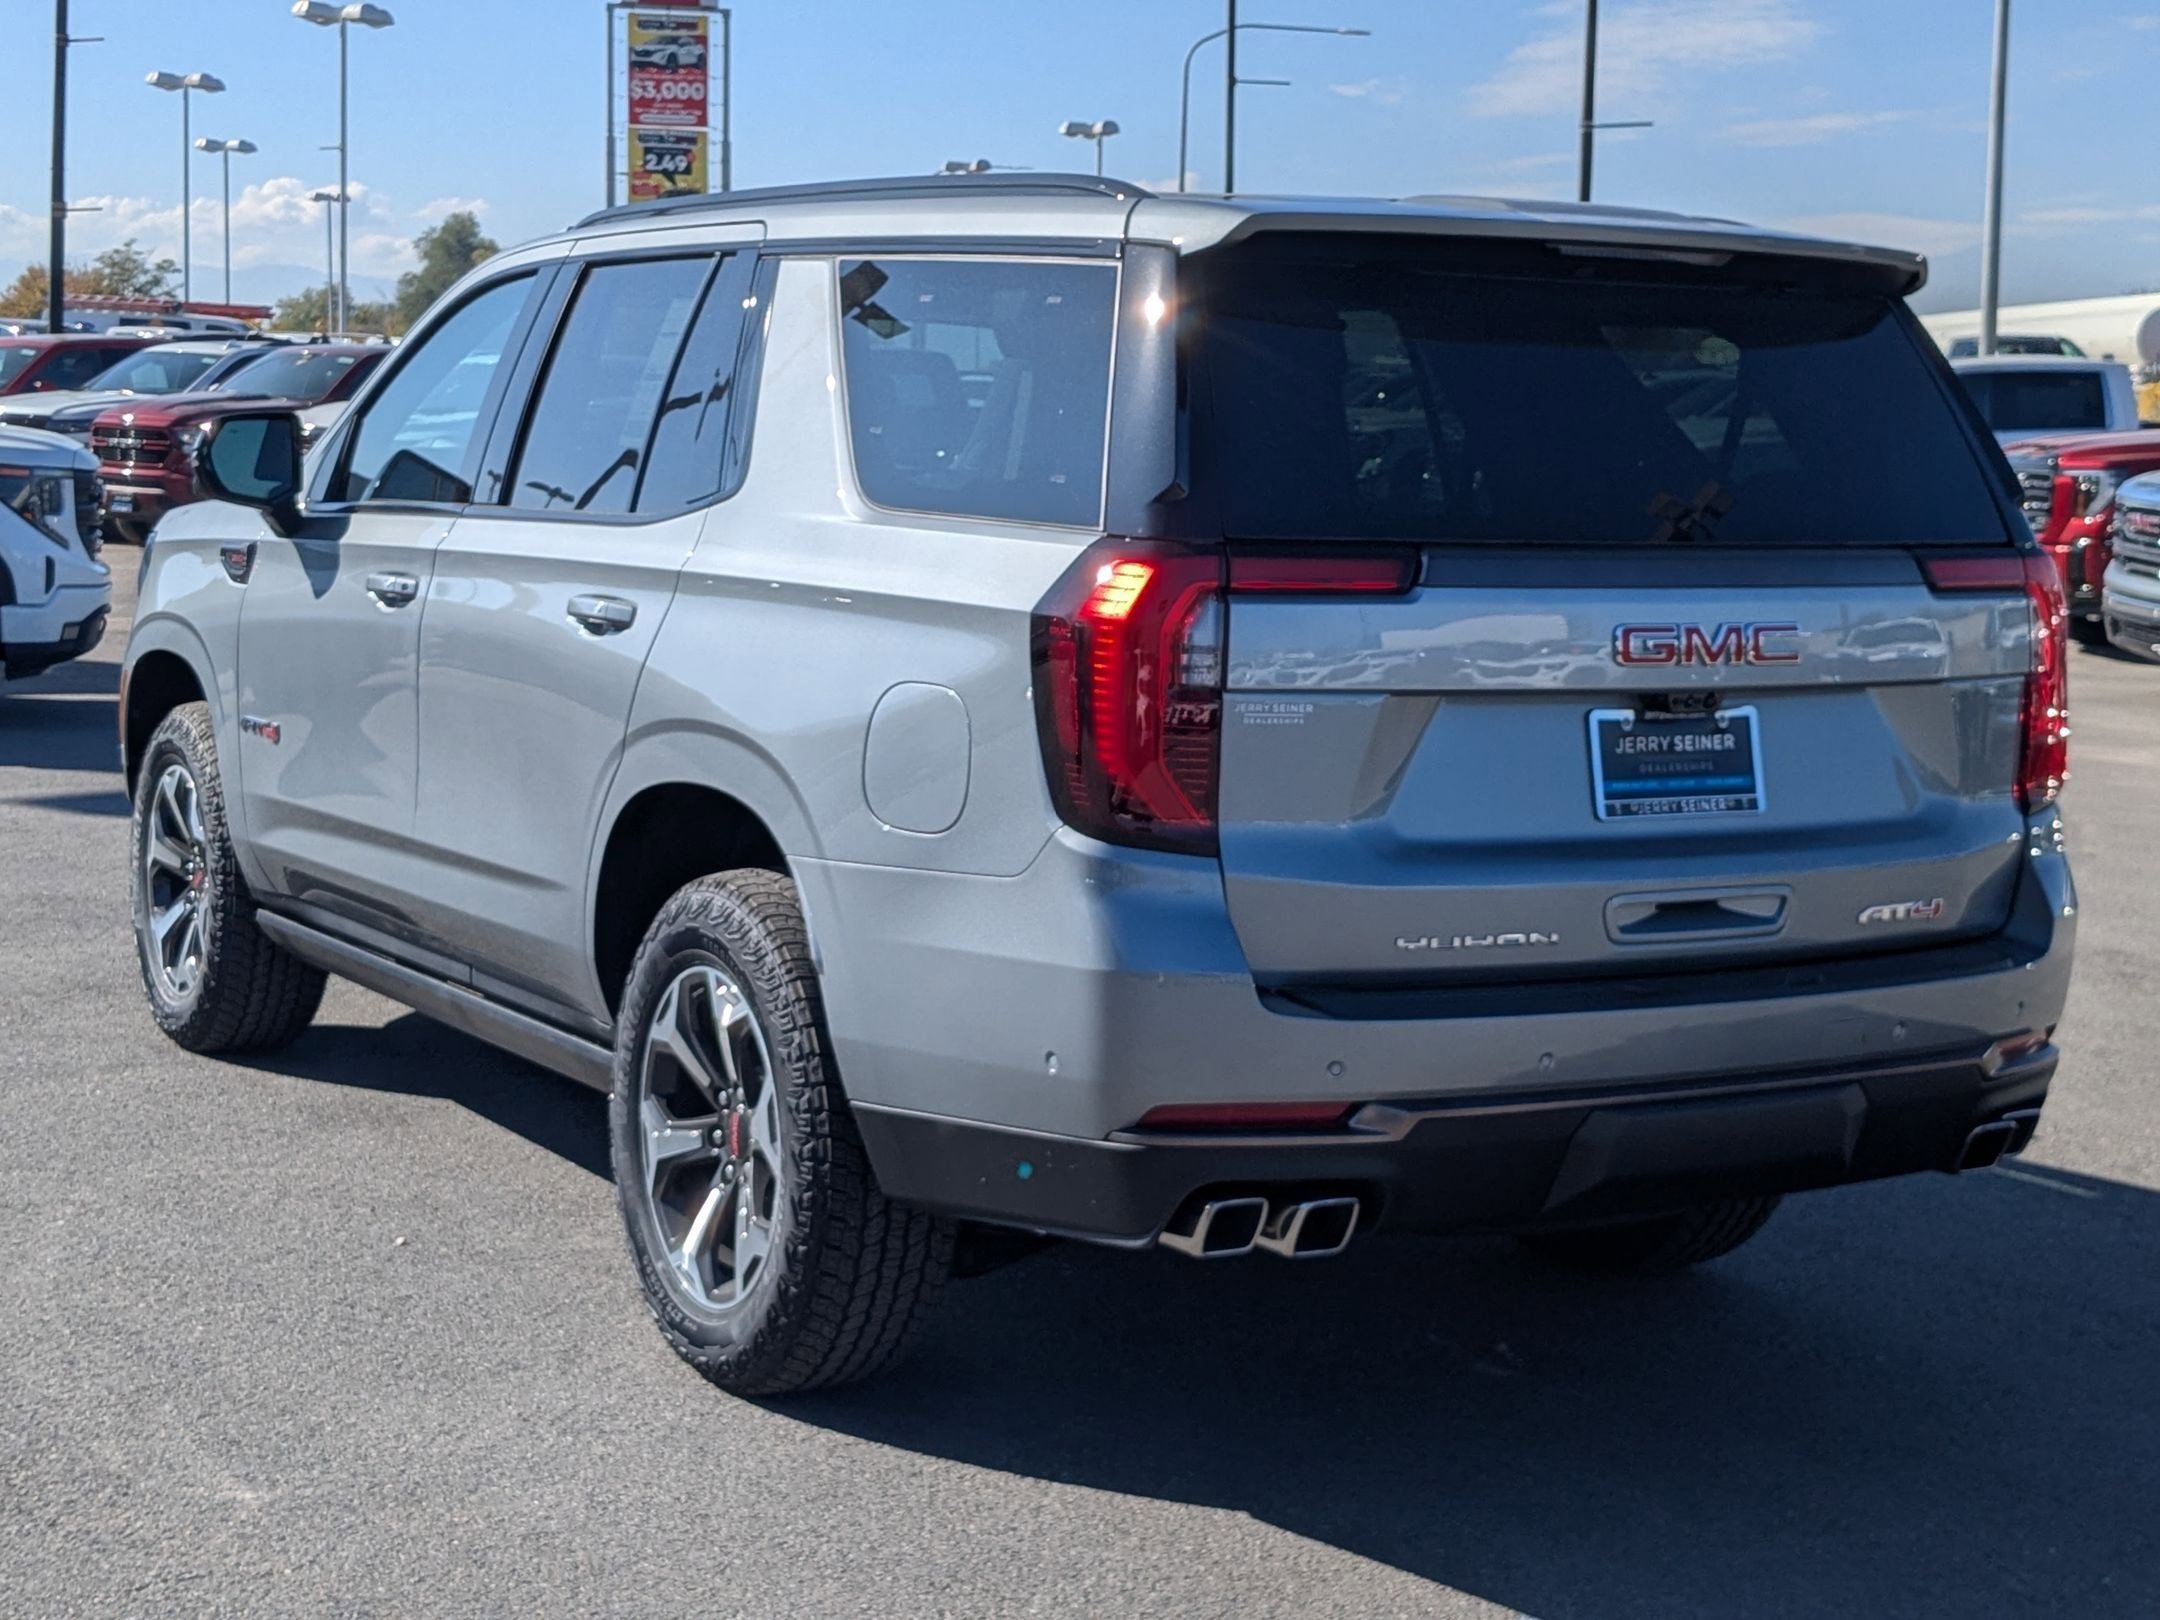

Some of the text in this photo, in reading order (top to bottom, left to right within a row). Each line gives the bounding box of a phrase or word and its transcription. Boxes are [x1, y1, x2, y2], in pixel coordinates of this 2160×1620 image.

[630, 80, 705, 103] $3,000
[1614, 622, 1801, 666] GMC
[1234, 703, 1314, 713] JERRY SEINER
[1615, 733, 1735, 754] JERRY SEINER
[1638, 760, 1715, 774] DEALERSHIPS
[1638, 798, 1729, 815] JERRY SEINER
[1858, 898, 1943, 924] AT4
[1396, 932, 1559, 949] YUKON
